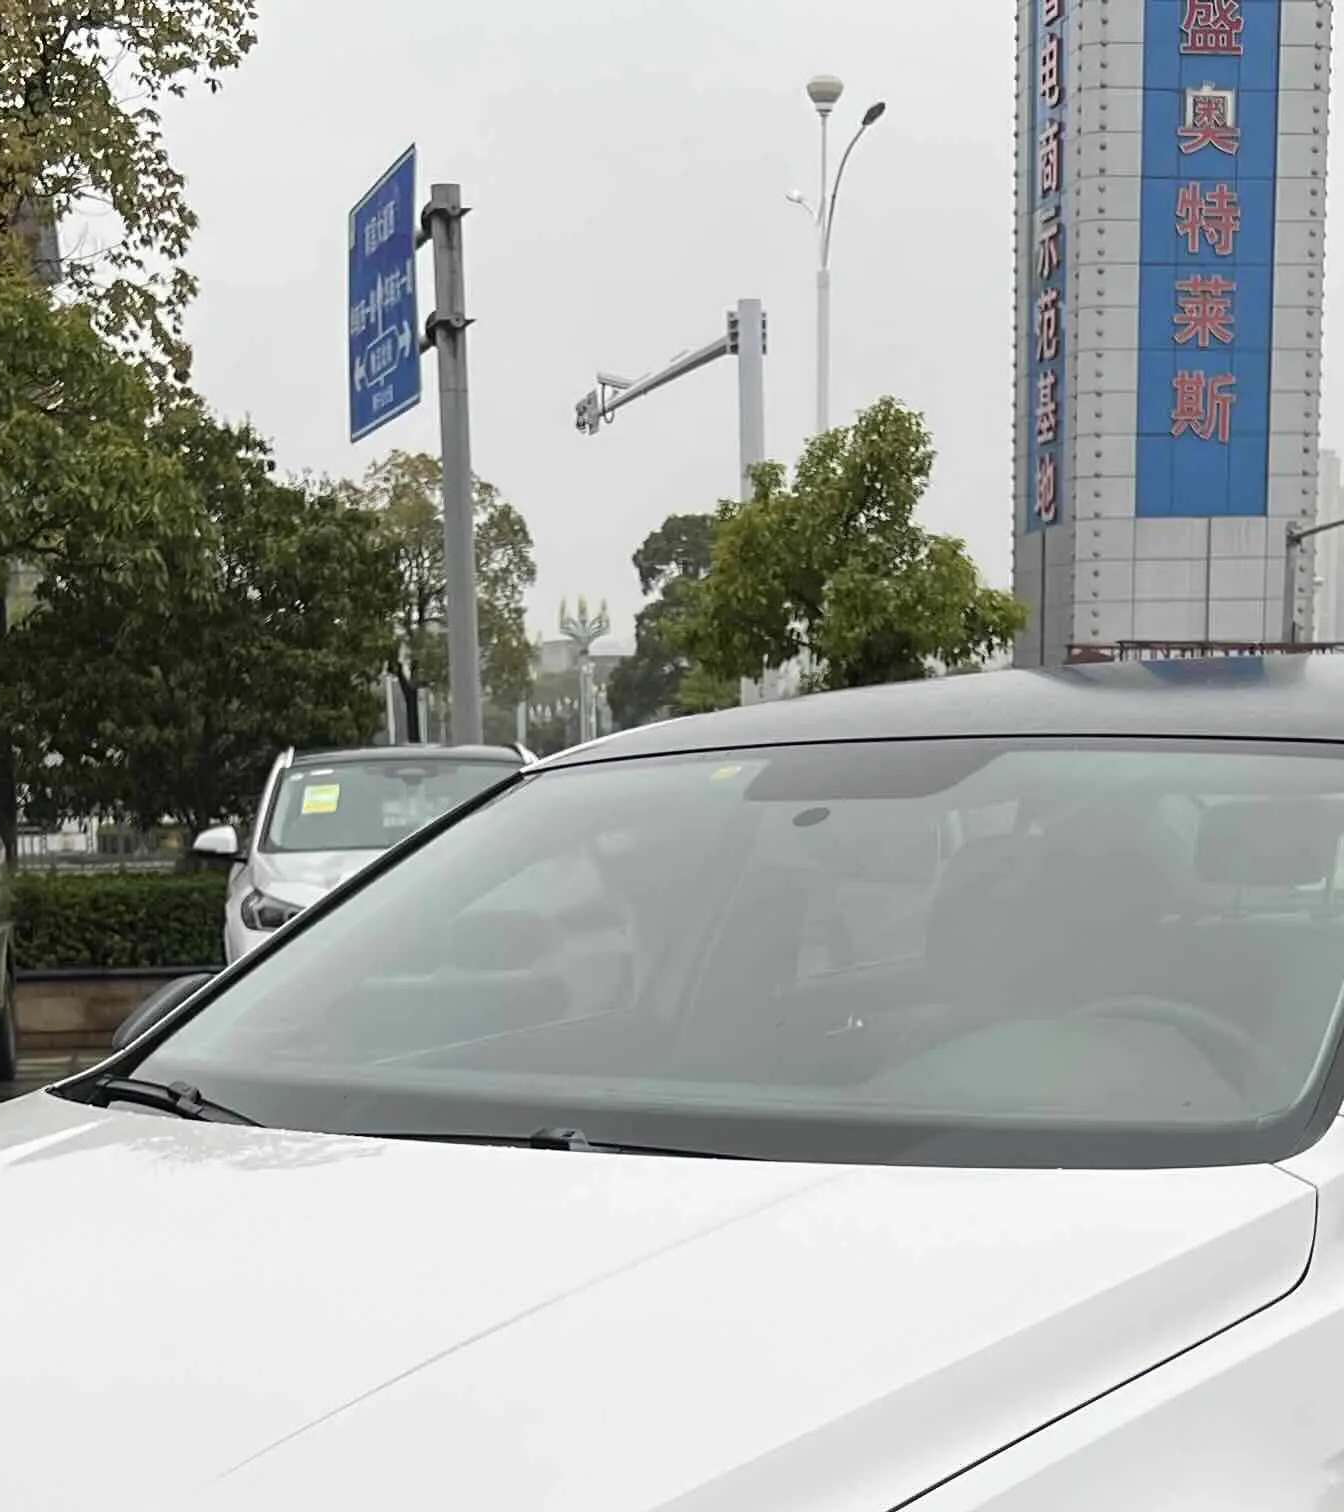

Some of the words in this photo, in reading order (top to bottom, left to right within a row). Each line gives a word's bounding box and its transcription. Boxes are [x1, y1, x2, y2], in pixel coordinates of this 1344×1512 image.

[1170, 0, 1244, 443] 盛奥特莱斯
